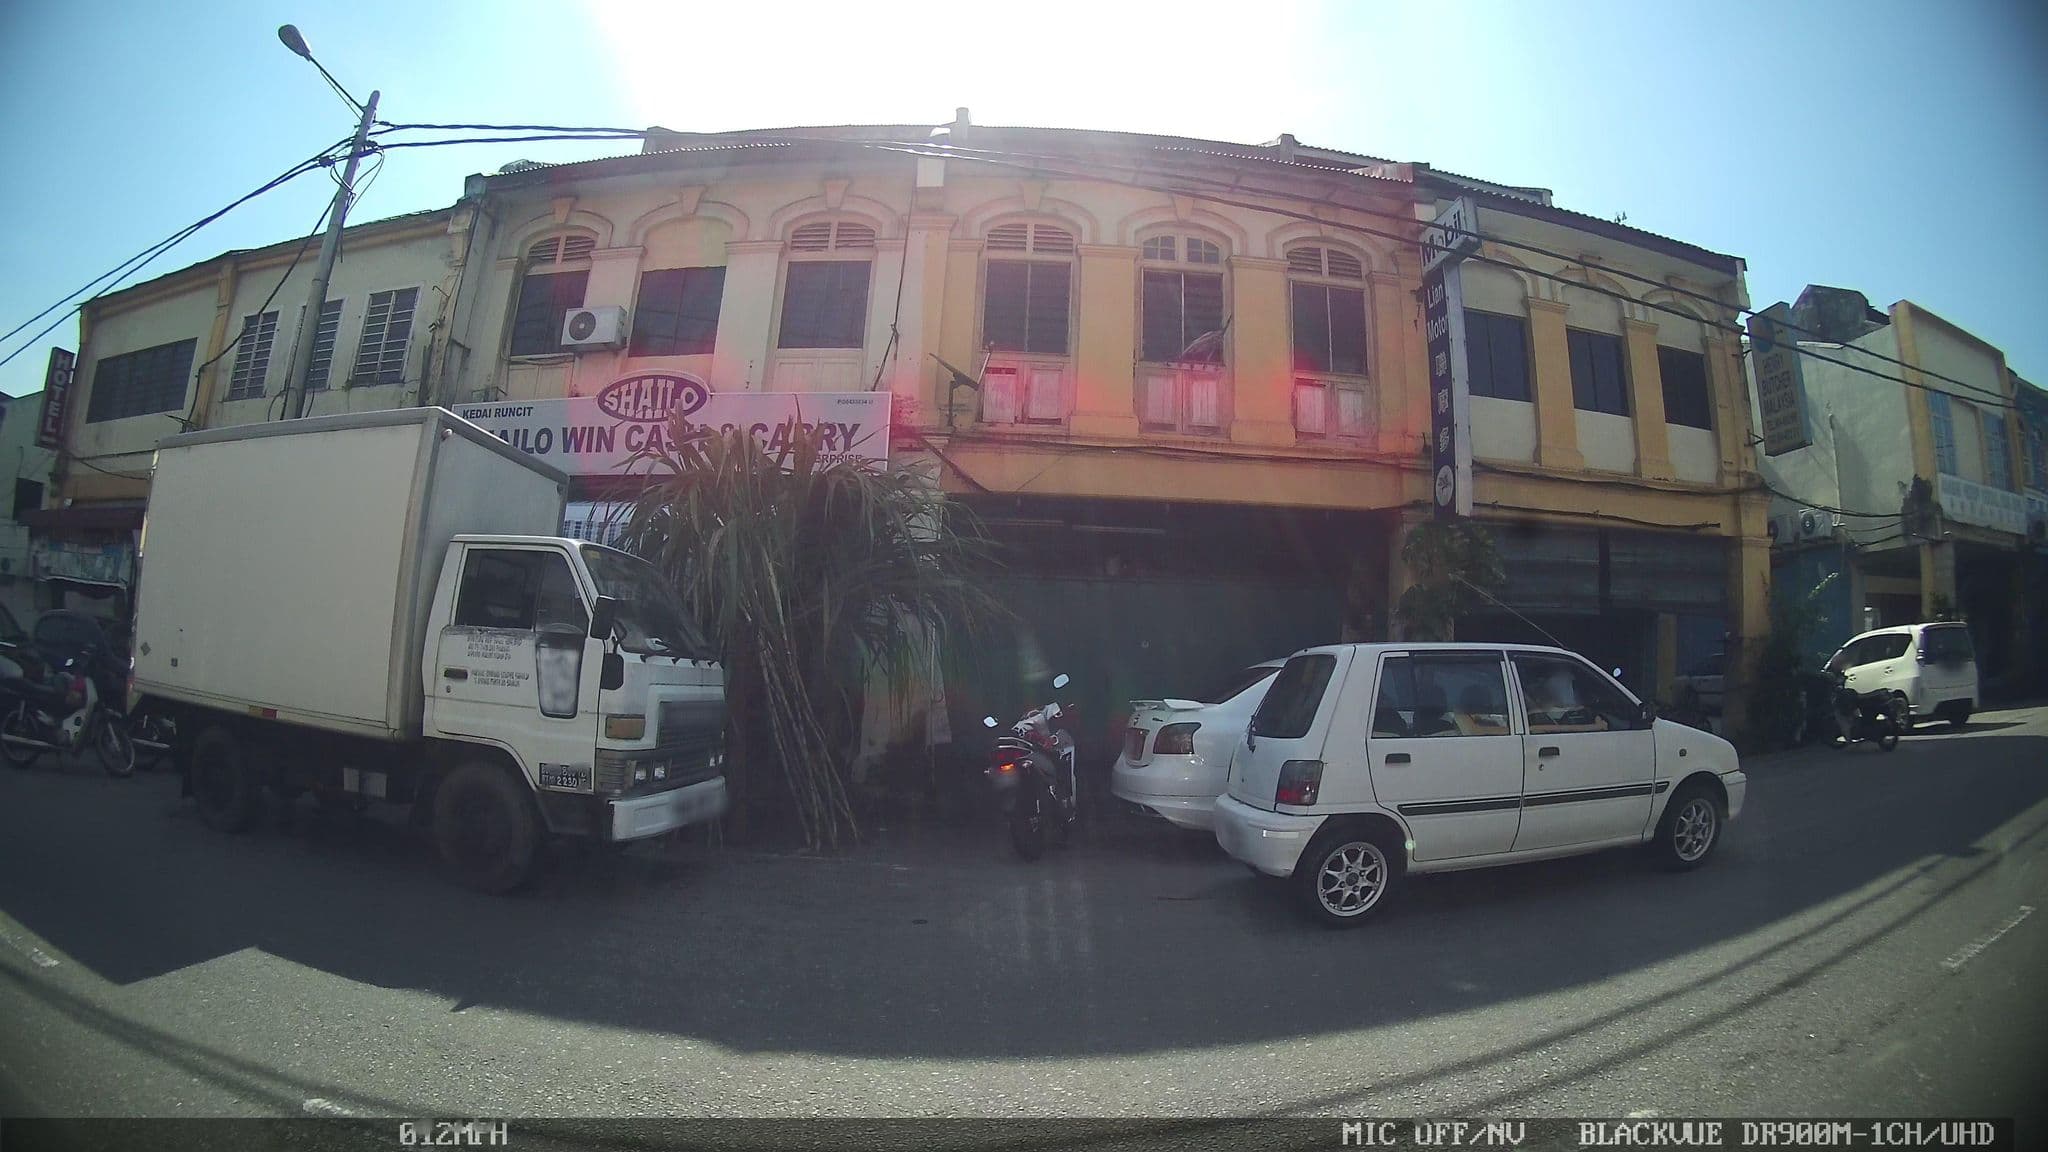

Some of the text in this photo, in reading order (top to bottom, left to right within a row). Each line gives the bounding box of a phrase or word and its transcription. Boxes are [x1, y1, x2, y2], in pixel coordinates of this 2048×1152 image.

[1420, 210, 1461, 268] Mobil
[1427, 282, 1445, 309] Lian
[1427, 315, 1449, 343] Motor
[46, 352, 71, 434] HOTEL
[604, 378, 699, 419] SHAILO
[463, 406, 533, 419] KEDAI RUNCIT
[562, 425, 617, 454] WIN
